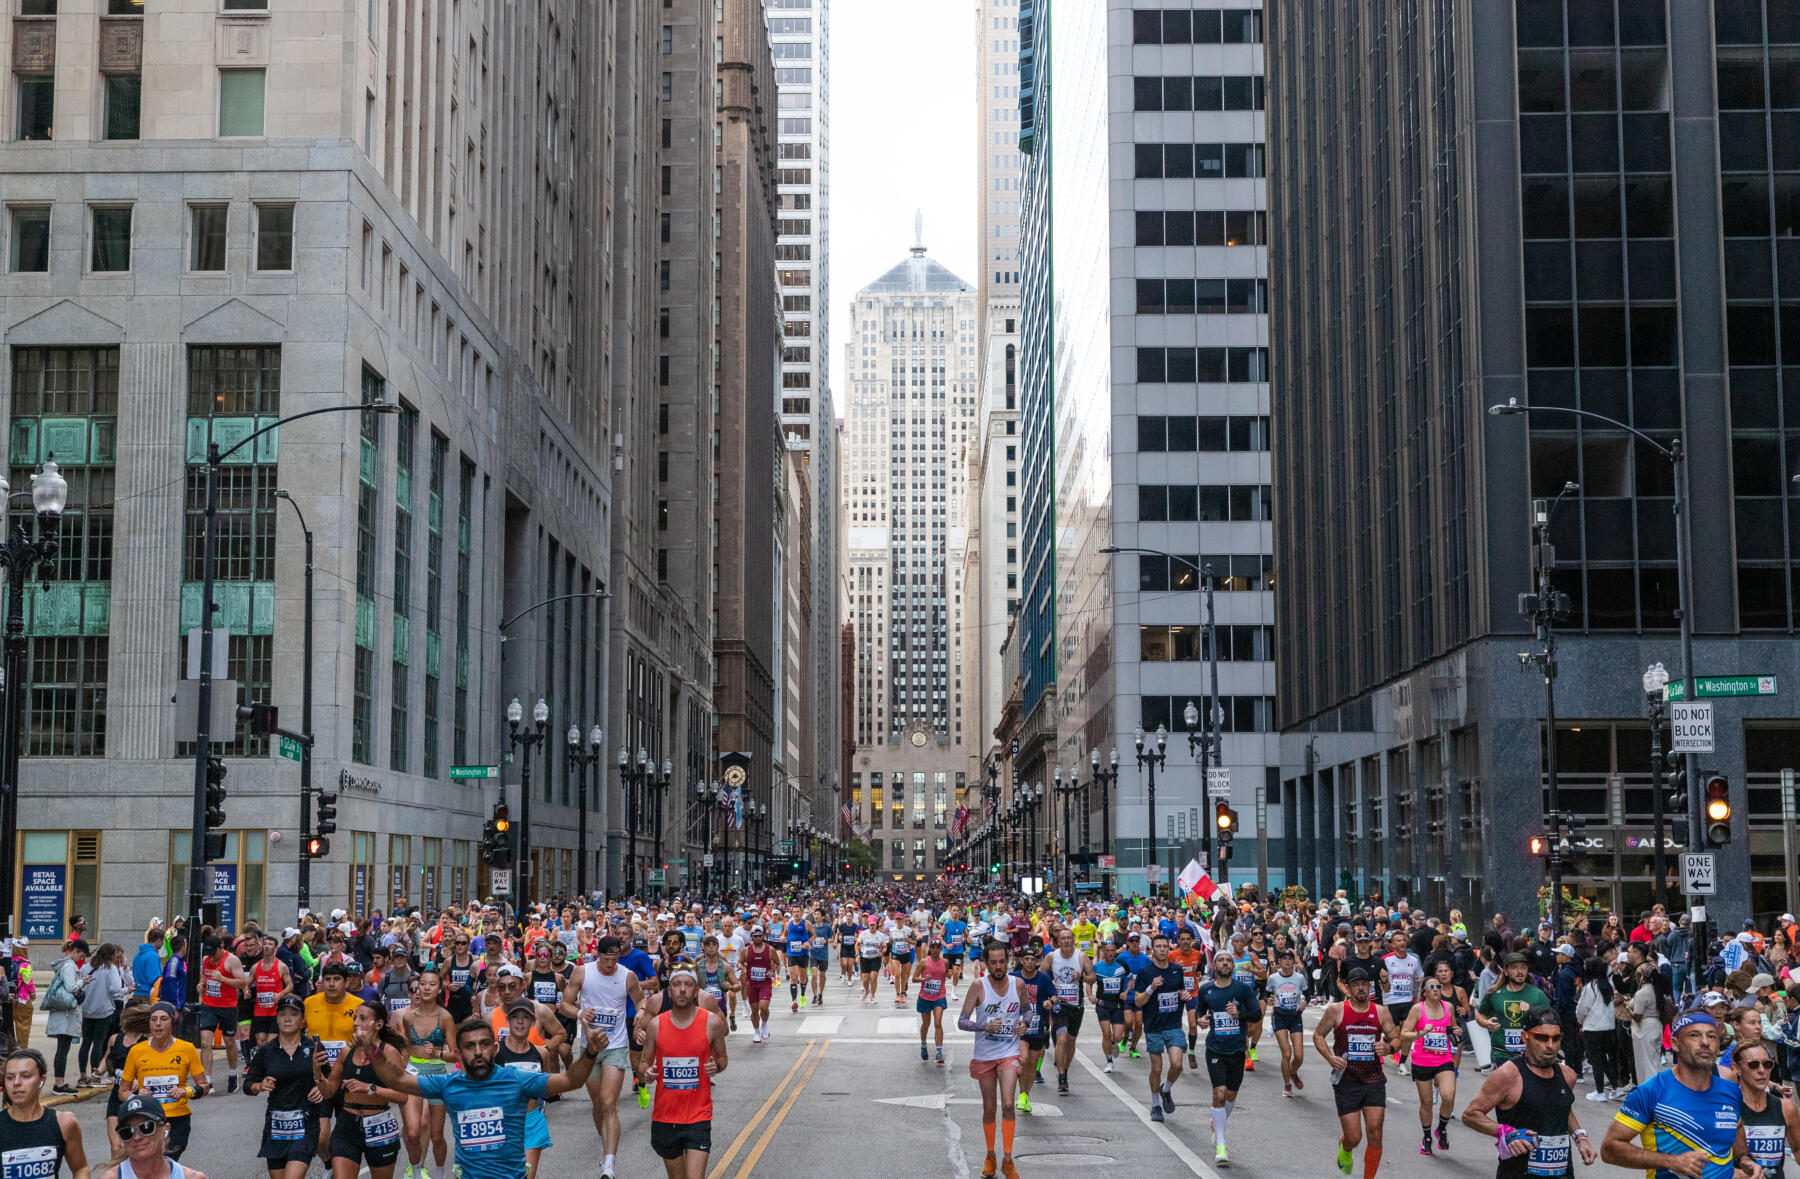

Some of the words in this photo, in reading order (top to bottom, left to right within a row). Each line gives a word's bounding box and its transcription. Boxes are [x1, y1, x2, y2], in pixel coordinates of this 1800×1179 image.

[1705, 681, 1748, 694] Washington
[1674, 709, 1688, 720] DO
[1691, 709, 1710, 720] NOT
[1675, 725, 1711, 736] BLOCK
[1675, 740, 1712, 748] INTERSECTION
[456, 768, 481, 777] Washington
[1208, 771, 1217, 779] DO
[1218, 771, 1230, 779] NOT
[1688, 857, 1710, 867] ONE
[1688, 868, 1712, 878] WAY
[1349, 1043, 1353, 1051] E
[1424, 1038, 1429, 1046] D
[1431, 1039, 1447, 1047] 2545
[664, 1068, 669, 1077] E
[672, 1068, 698, 1077] 16023
[272, 1120, 277, 1128] E
[279, 1119, 304, 1129] 19991
[365, 1127, 372, 1137] E
[375, 1119, 398, 1135] 4155
[460, 1124, 468, 1138] E
[471, 1120, 503, 1136] 8954
[1530, 1149, 1537, 1160] E
[1541, 1149, 1569, 1161] 15094
[3, 1166, 12, 1178] E
[17, 1161, 55, 1177] 10682
